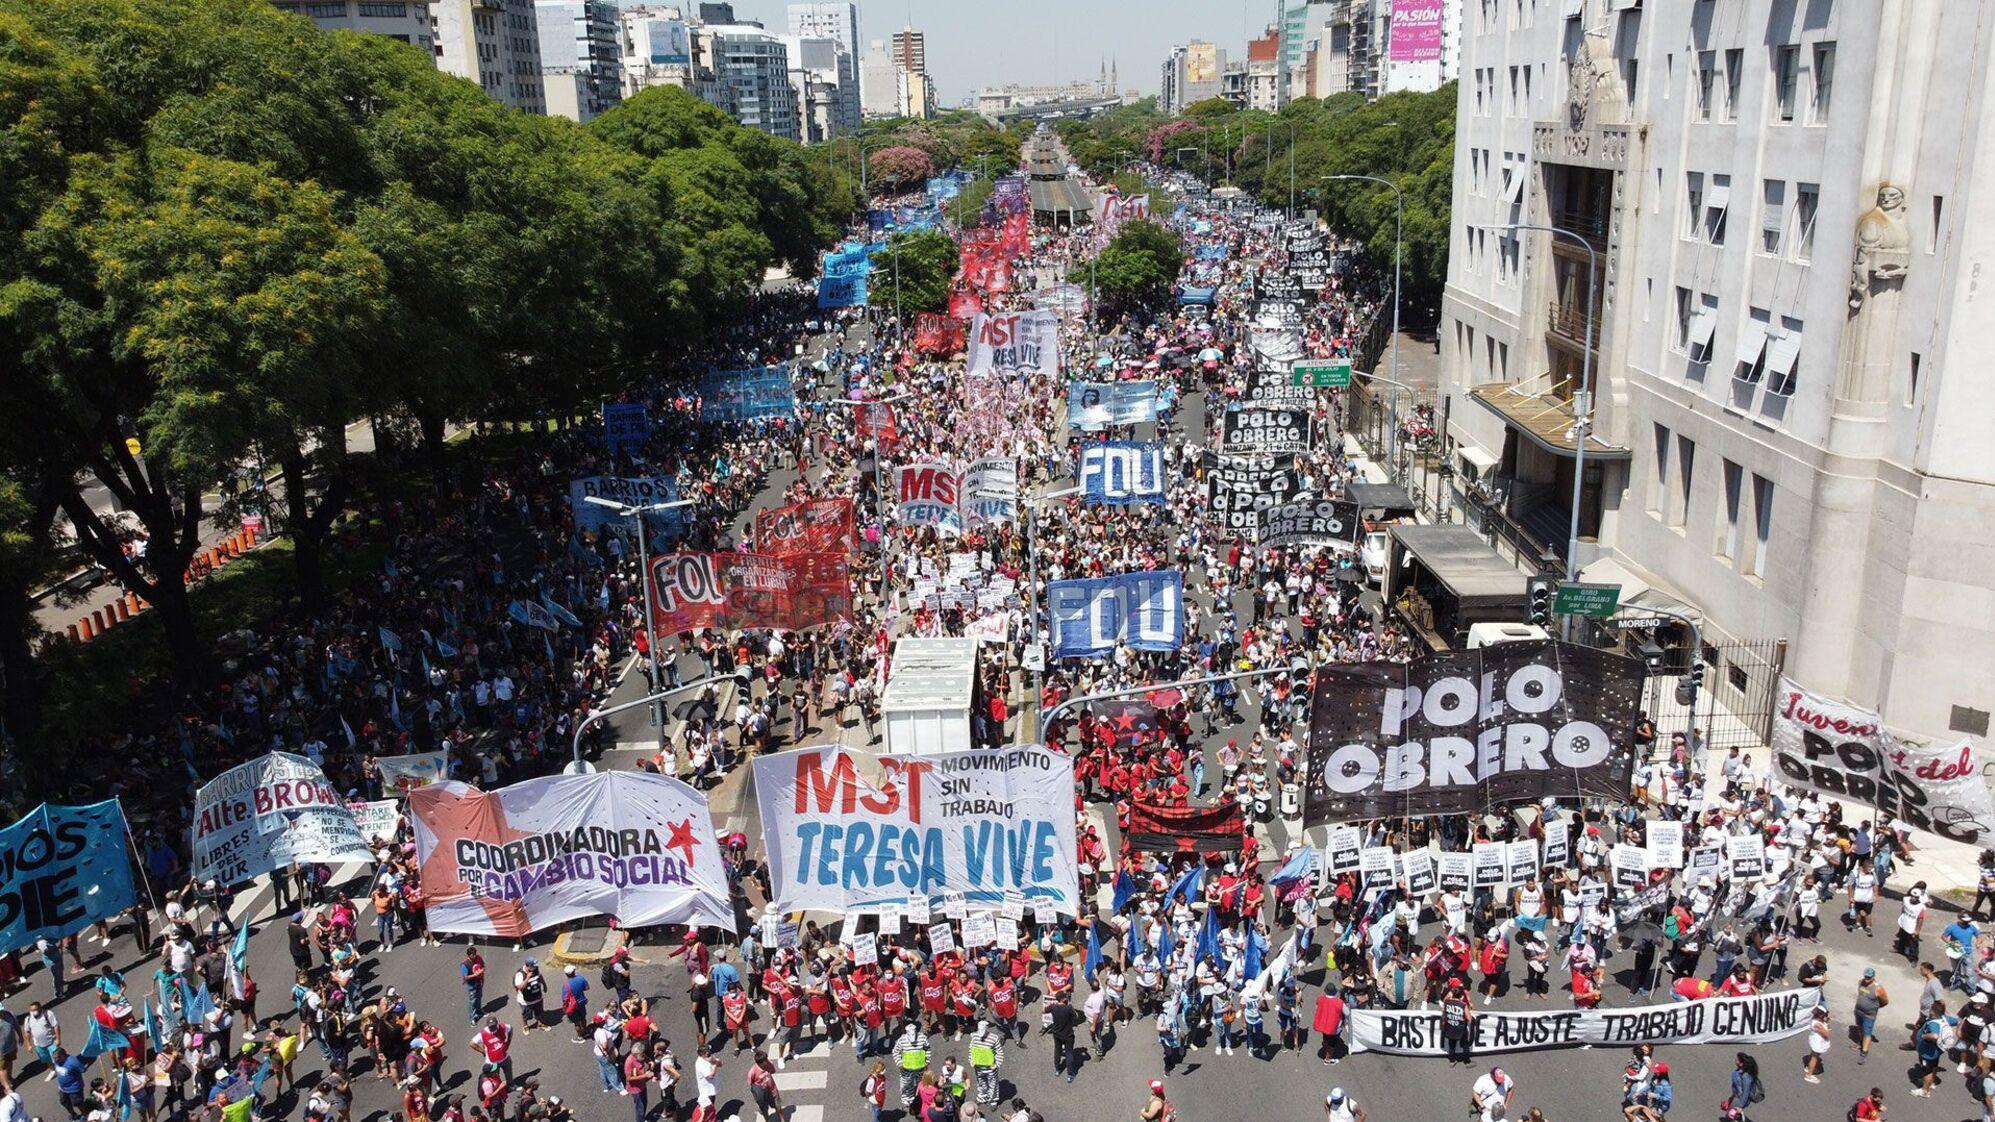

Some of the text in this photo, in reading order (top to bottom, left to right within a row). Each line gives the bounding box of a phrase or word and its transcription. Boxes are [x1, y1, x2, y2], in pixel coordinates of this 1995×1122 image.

[1393, 5, 1441, 22] PASIÓN
[1294, 252, 1324, 260] POLO
[1260, 303, 1296, 314] POLO
[1252, 386, 1315, 400] OBRERO
[1238, 412, 1292, 428] POLO
[1230, 427, 1300, 444] OBRERO
[1217, 455, 1275, 471] POLO
[584, 479, 668, 498] BARRIOS
[1267, 502, 1334, 522] POLO
[1258, 517, 1343, 541] OBRERO
[652, 553, 726, 612] FOL
[744, 575, 788, 591] EN LUCHA
[1618, 618, 1660, 629] MORENO
[1381, 664, 1562, 736] POLO
[941, 751, 1050, 775] MOVIMIENTO
[1324, 721, 1610, 793] OBRERO
[1916, 747, 1974, 781] del
[795, 752, 932, 824] MST
[941, 779, 970, 796] SIN
[199, 798, 252, 838] Alte.
[941, 801, 1013, 819] TRABAJO
[1411, 821, 1425, 832] 14
[201, 829, 250, 868] LIBRES
[330, 835, 339, 844] SE
[456, 827, 662, 873] COORDINADORA
[797, 819, 1057, 894] TERESA VIVE
[218, 854, 240, 870] DEL
[458, 853, 695, 901] POR CAMBIO SOCIAL
[470, 885, 484, 898] EL
[1494, 1013, 1582, 1047] AJUSTE
[1602, 1004, 1703, 1042] TRABAJO
[1713, 993, 1799, 1037] GENUINO
